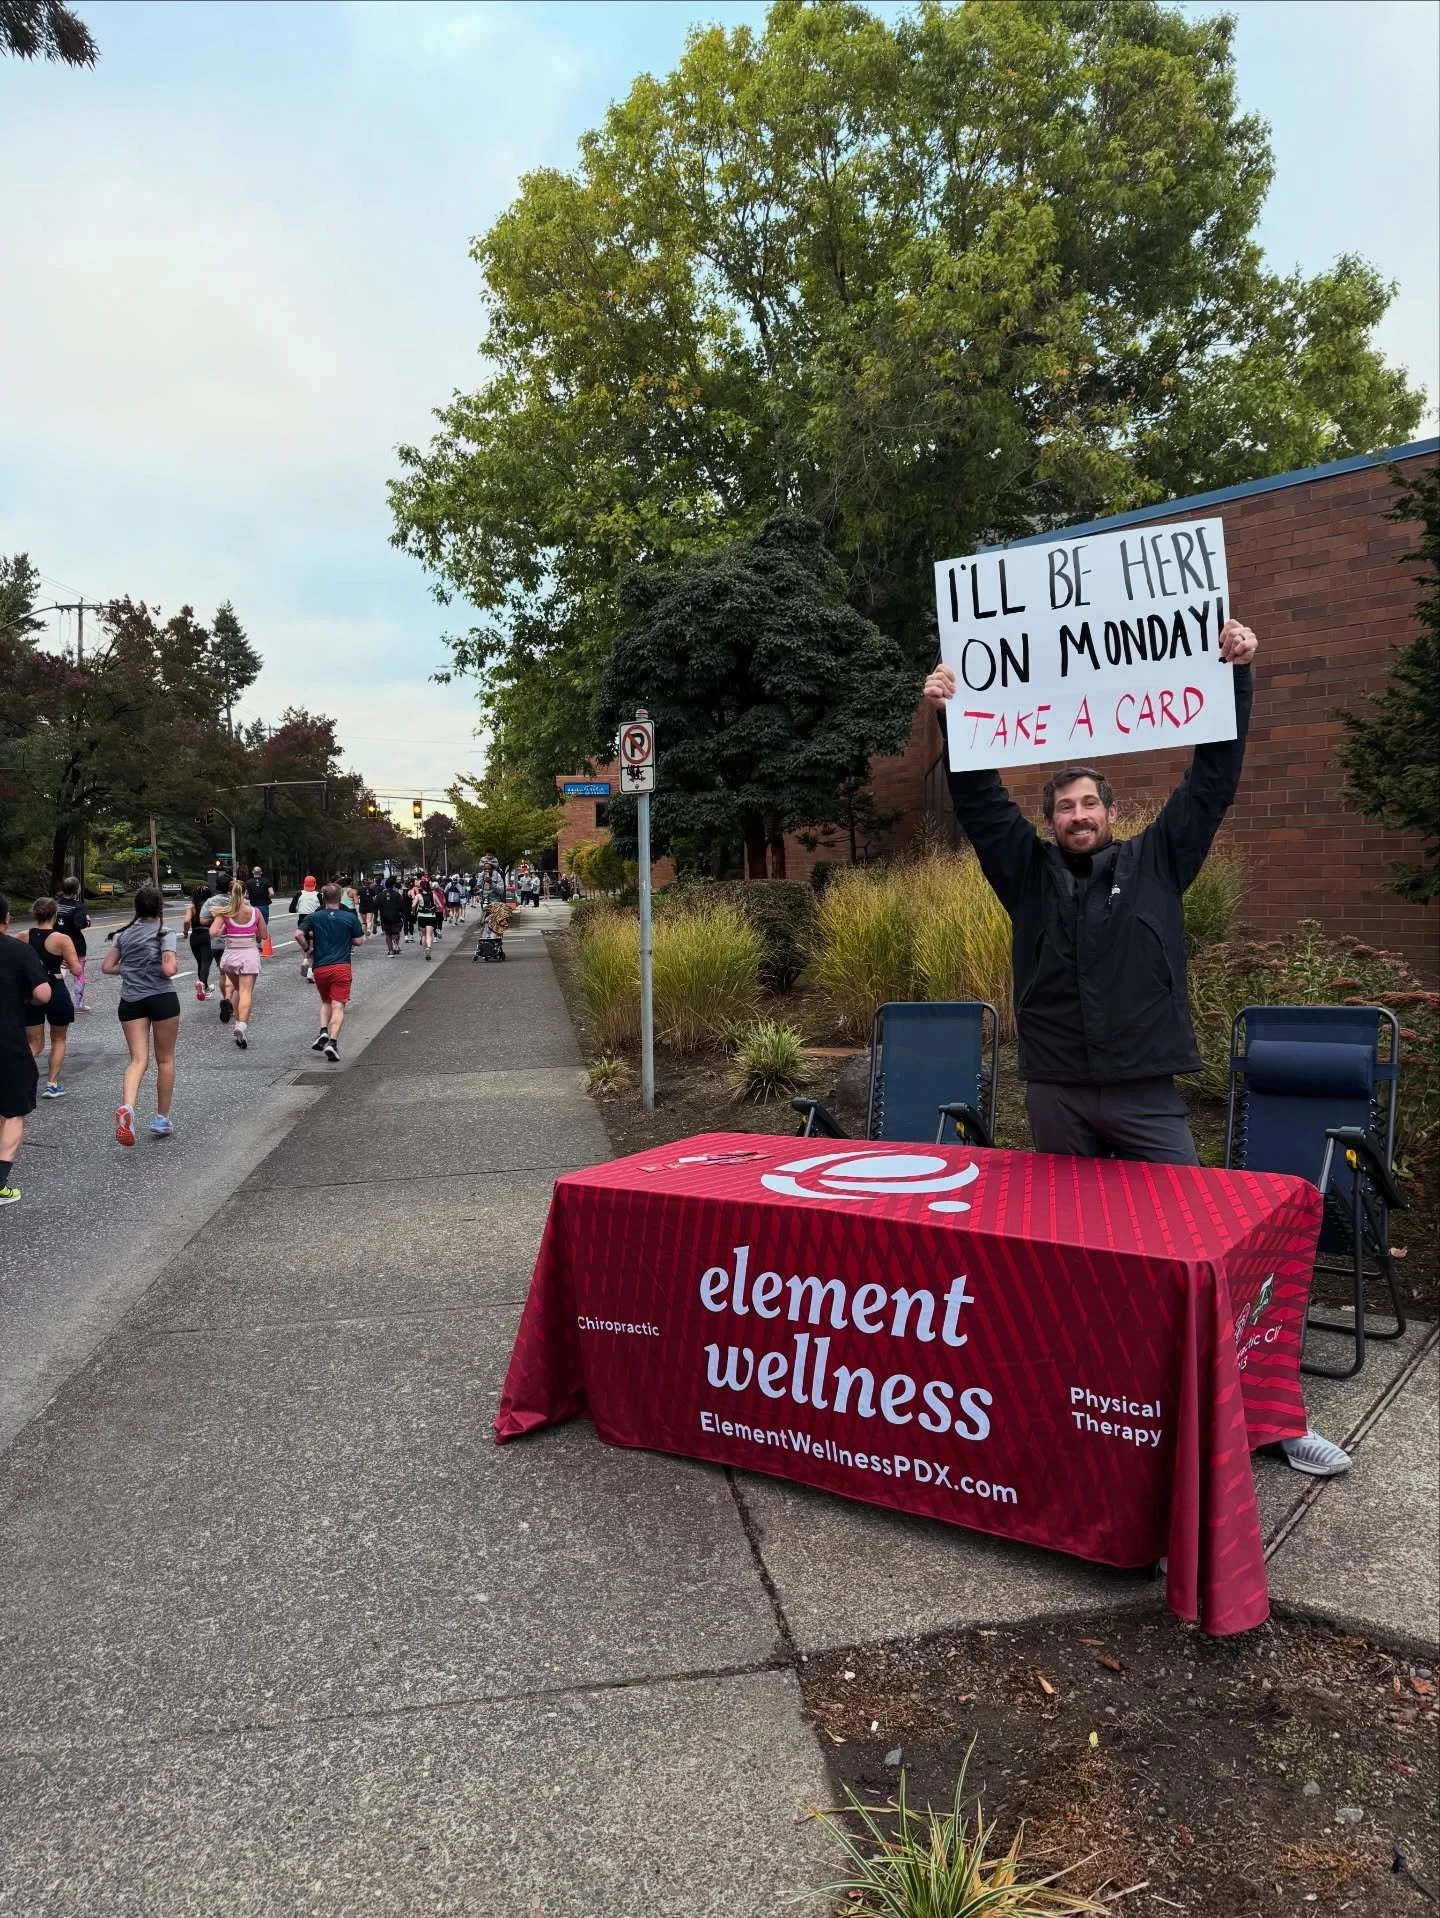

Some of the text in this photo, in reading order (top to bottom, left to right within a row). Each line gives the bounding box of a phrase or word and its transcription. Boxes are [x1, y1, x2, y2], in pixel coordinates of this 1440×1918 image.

[949, 526, 1221, 623] I'LL BE HERE
[961, 596, 1227, 692] ON MONDAY!
[964, 686, 1204, 749] TAKE A CARD
[577, 1316, 660, 1336] Chiropractic
[700, 1246, 975, 1347] element
[704, 1333, 993, 1441] wellness
[1070, 1387, 1161, 1418] Physical
[1071, 1412, 1162, 1448] Therapy
[700, 1411, 1018, 1504] ElementWellnessPDX.com
